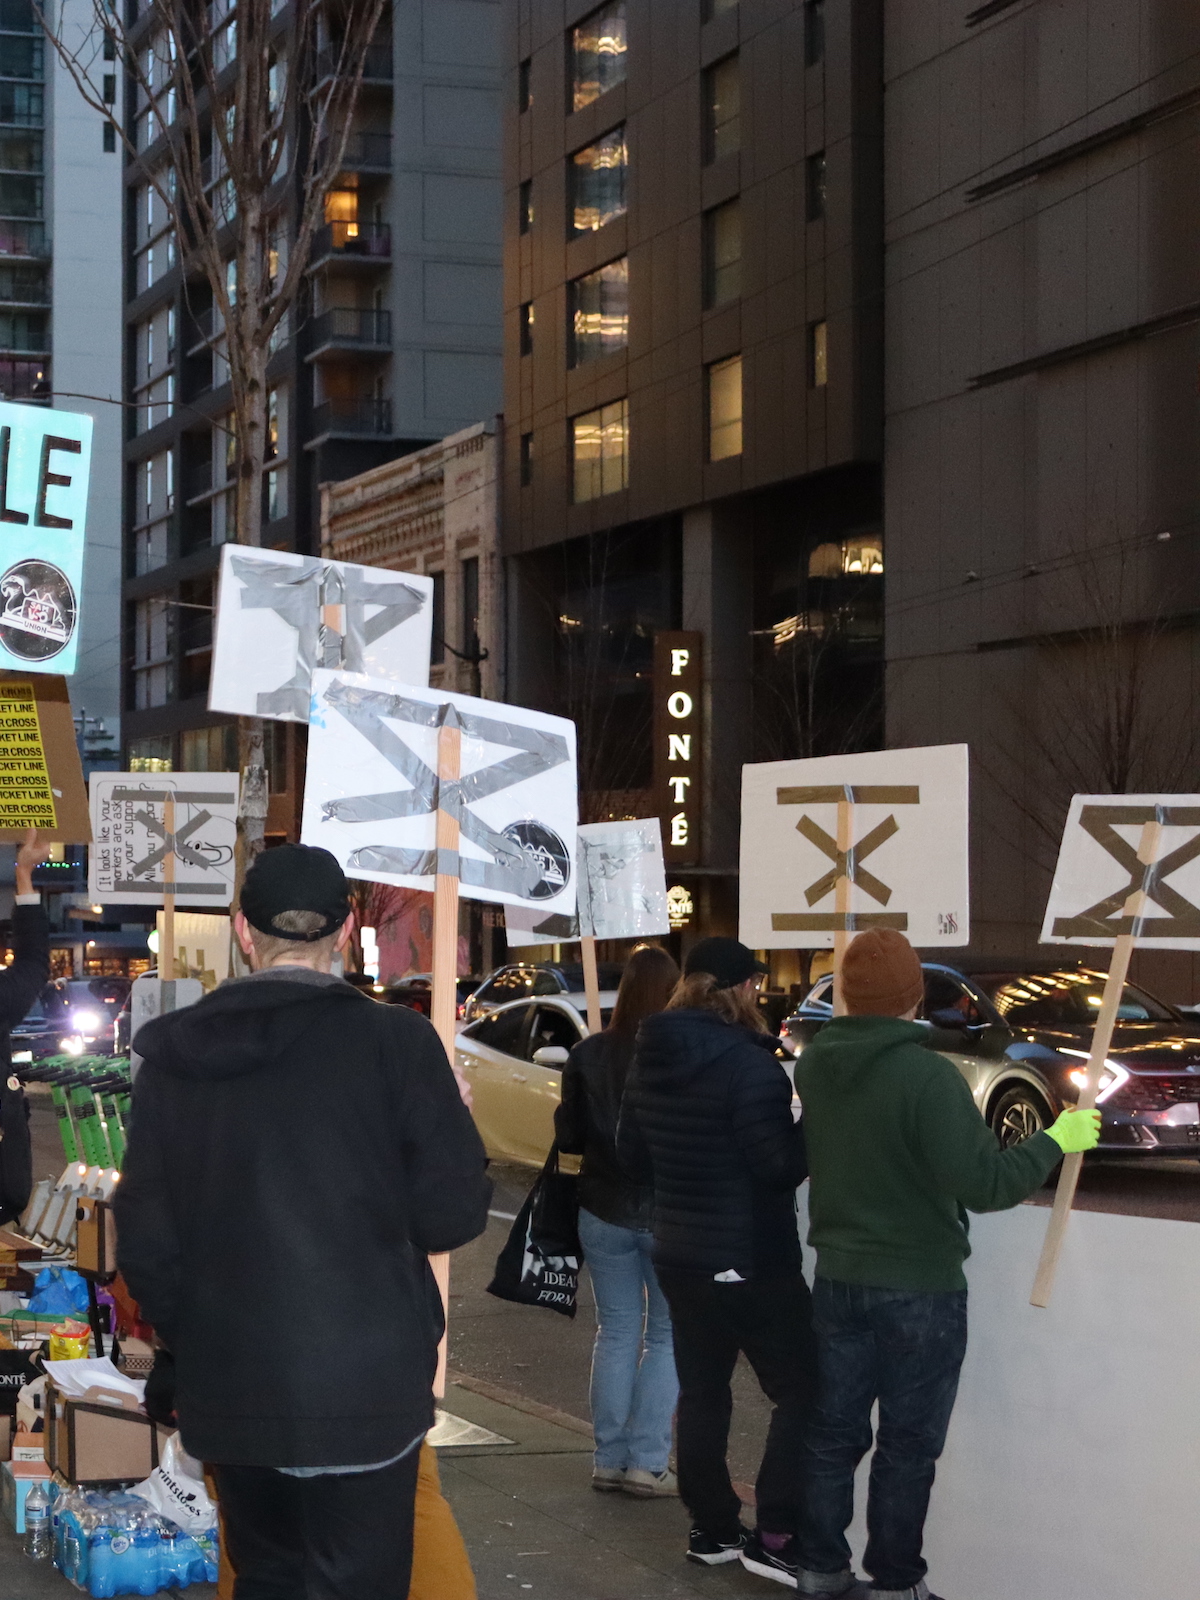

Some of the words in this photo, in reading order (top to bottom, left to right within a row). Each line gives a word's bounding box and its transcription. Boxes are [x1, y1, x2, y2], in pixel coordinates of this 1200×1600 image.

[23, 621, 48, 634] UNION
[1, 687, 33, 699] CROSS
[14, 704, 35, 713] LINE
[5, 718, 37, 727] CROSS
[18, 733, 40, 742] LINE
[10, 747, 42, 757] CROSS
[667, 649, 693, 845] FONTÉ
[23, 762, 45, 770] LINE
[15, 776, 48, 785] CROSS
[28, 790, 50, 799] LINE
[20, 804, 53, 814] CROSS
[101, 797, 113, 821] your
[0, 818, 32, 828] PICKET
[34, 818, 56, 828] LINE
[98, 826, 110, 843] like
[113, 823, 123, 843] are
[98, 848, 111, 871] looks
[99, 875, 112, 886] It
[124, 870, 134, 882] or
[667, 900, 694, 914] ONTÉ
[158, 1468, 202, 1517] rintstores
